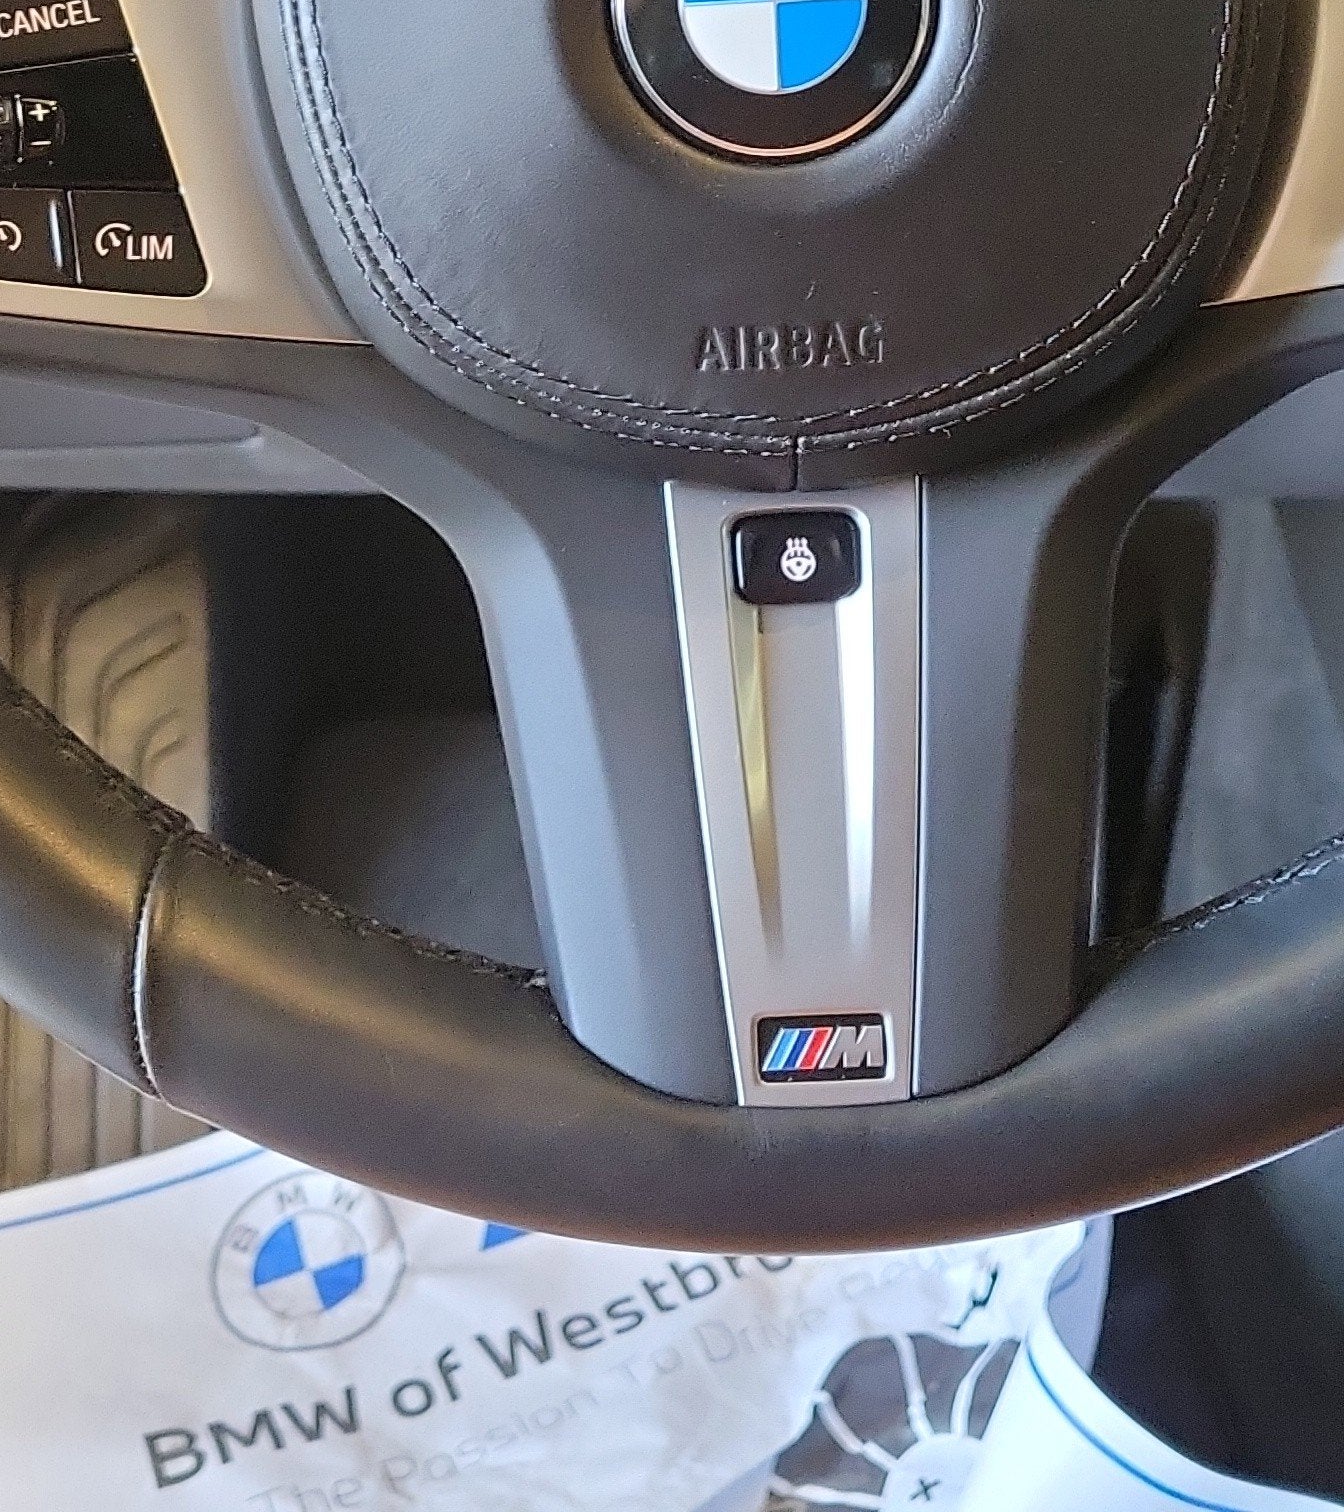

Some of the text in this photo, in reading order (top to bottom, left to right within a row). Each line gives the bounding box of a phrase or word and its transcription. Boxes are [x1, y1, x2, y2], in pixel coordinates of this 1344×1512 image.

[126, 234, 173, 260] LIM
[694, 318, 886, 372] AIRBAG
[144, 1384, 361, 1489] BMW
[392, 1346, 461, 1418] of
[383, 1388, 599, 1501] Passion
